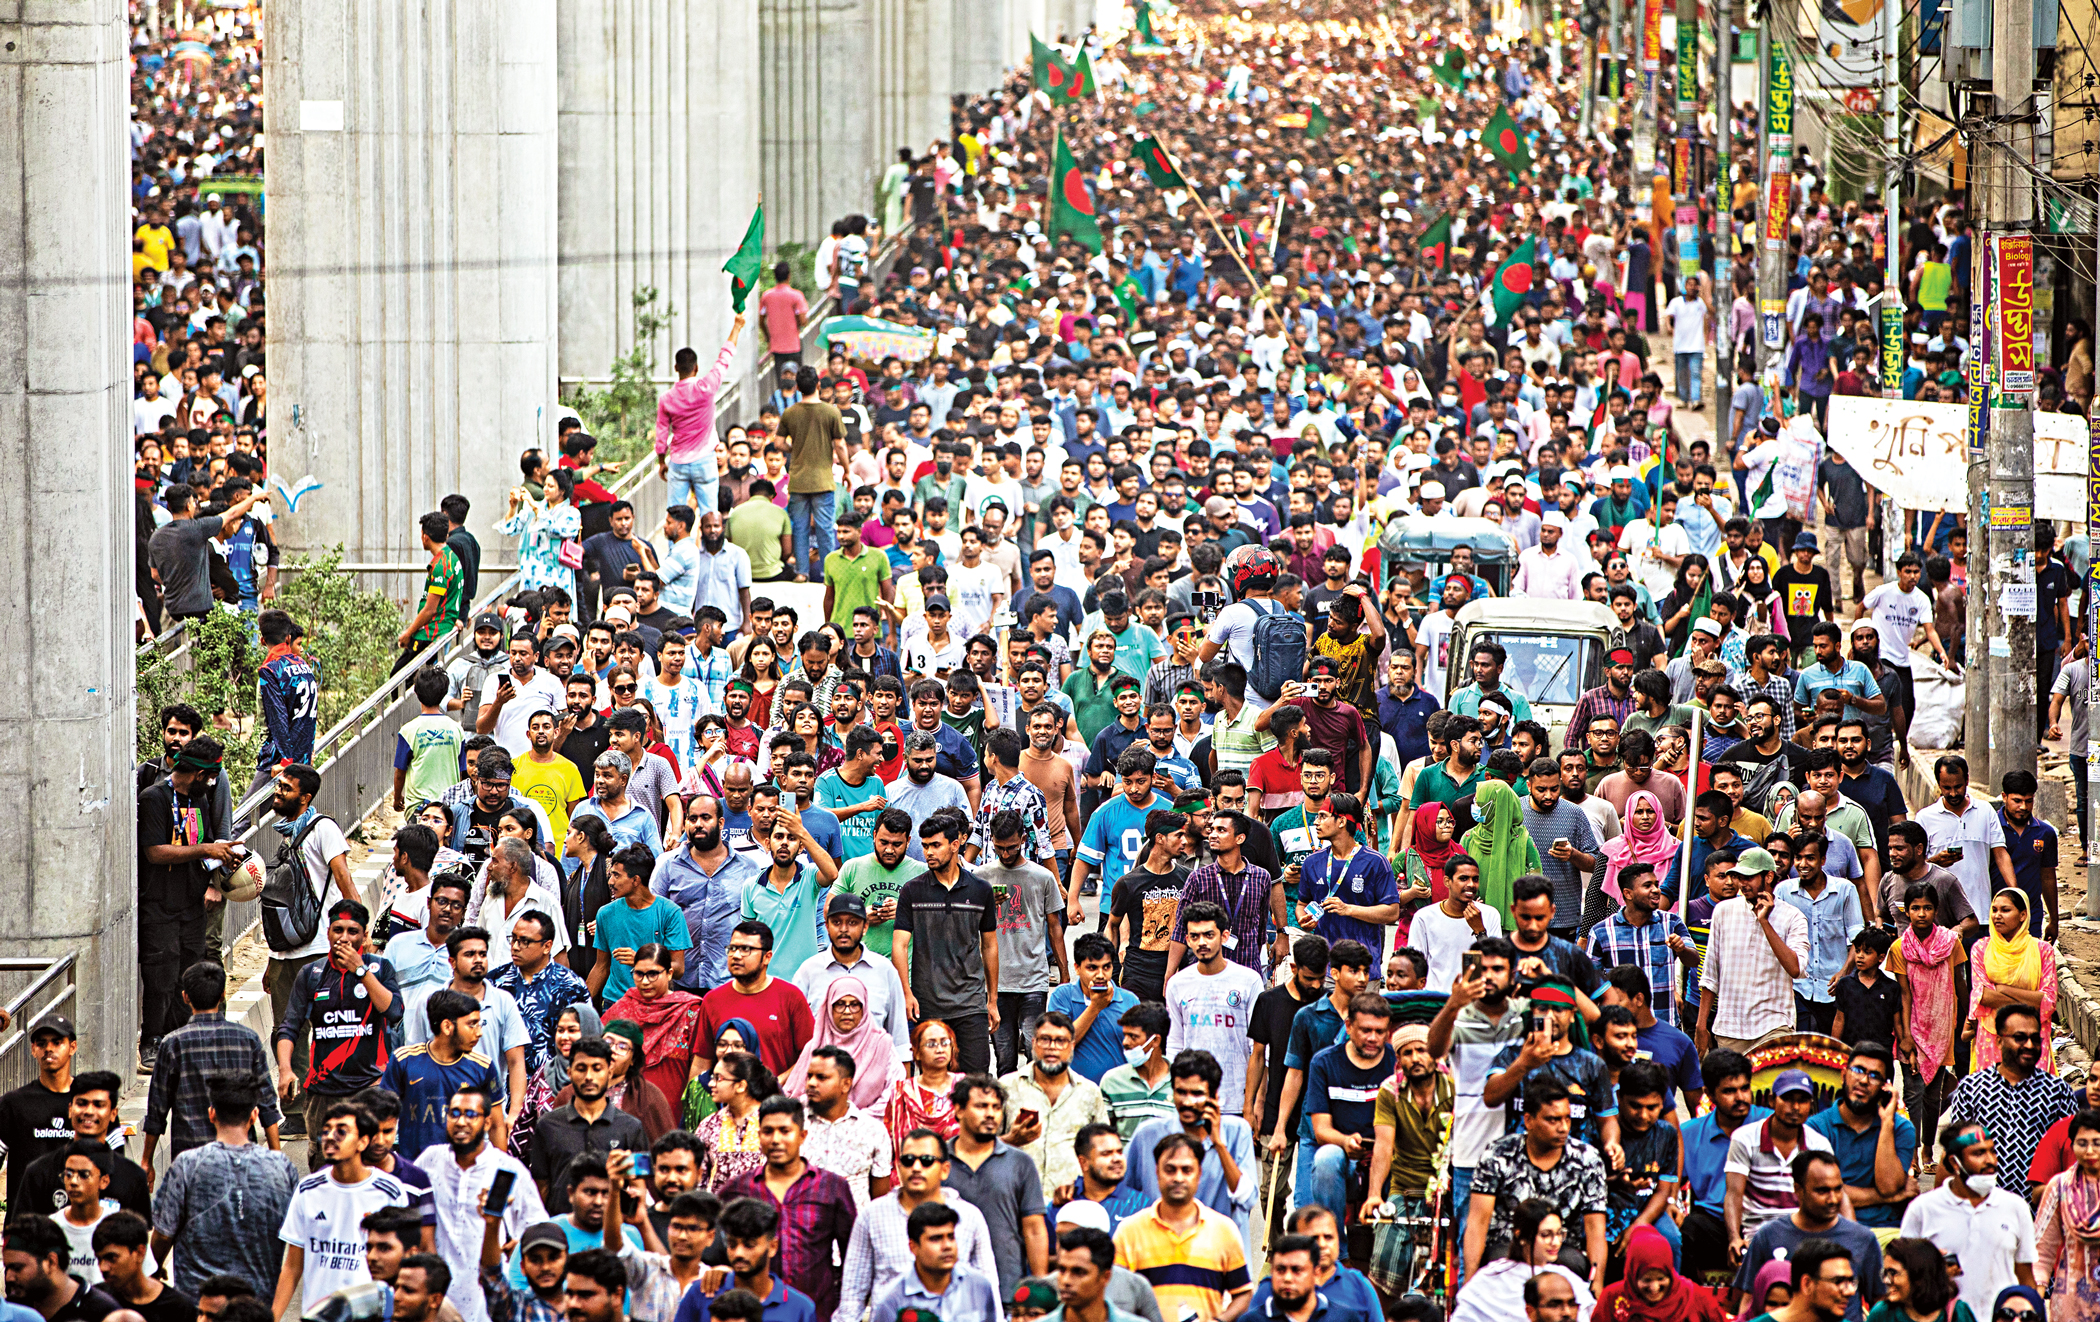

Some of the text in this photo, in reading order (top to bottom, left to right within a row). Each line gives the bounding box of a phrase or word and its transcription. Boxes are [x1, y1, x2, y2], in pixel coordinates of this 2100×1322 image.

[2004, 269, 2033, 369] উদ্ভাস
[917, 655, 926, 669] 3
[292, 680, 318, 721] 32
[323, 1009, 362, 1024] CIVIL
[315, 1023, 373, 1039] ENGINEERING
[33, 1127, 76, 1139] balenciag
[309, 1236, 366, 1256] Emirate
